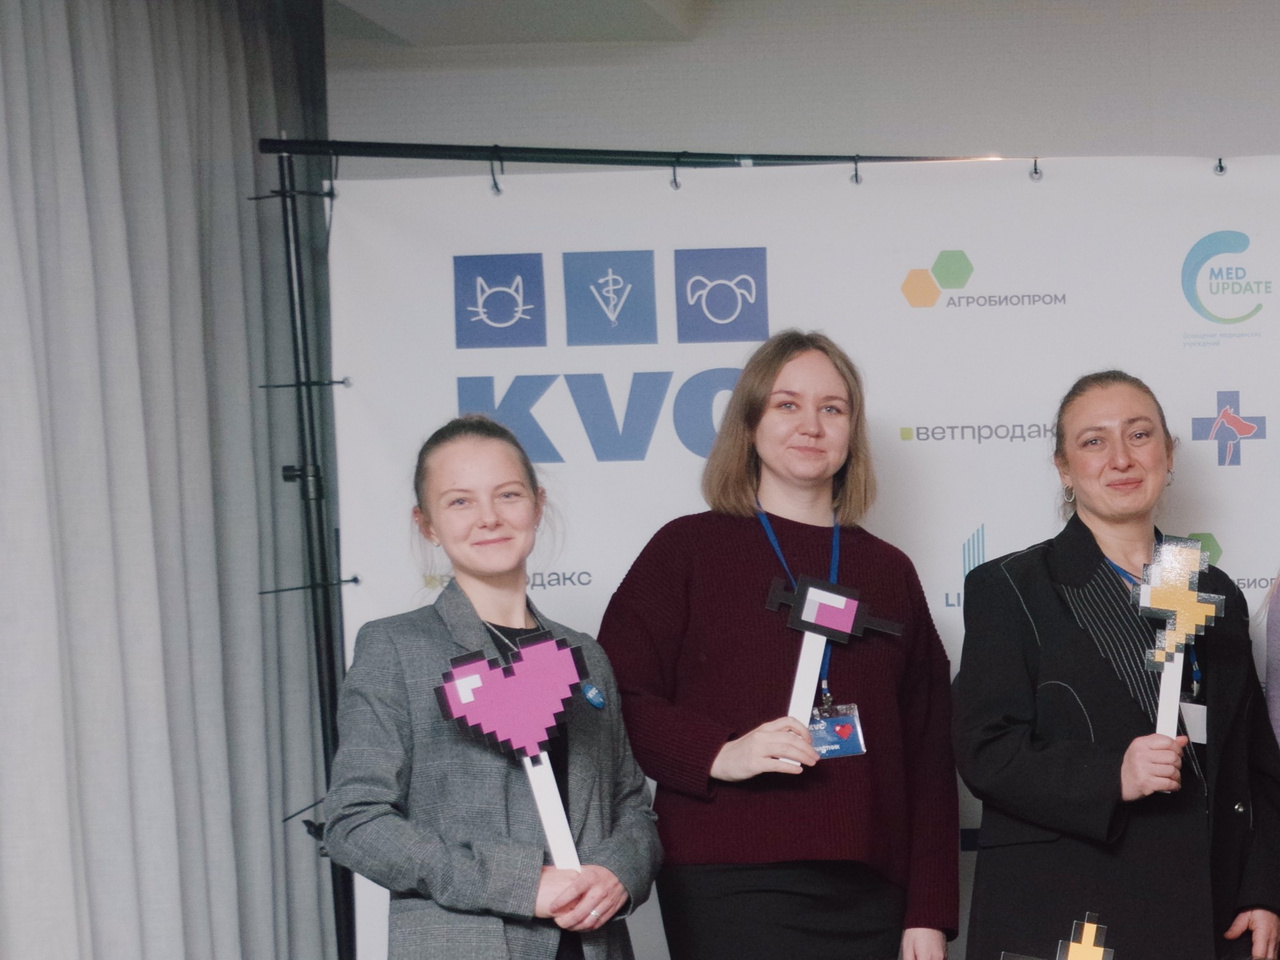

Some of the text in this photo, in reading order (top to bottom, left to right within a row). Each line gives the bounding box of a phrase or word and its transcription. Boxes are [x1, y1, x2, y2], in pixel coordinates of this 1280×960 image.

[1209, 266, 1247, 281] MED
[1209, 281, 1273, 295] UPDATE
[946, 293, 1067, 308] АГРОБИОПРОМ
[916, 423, 1058, 444] ветпродак
